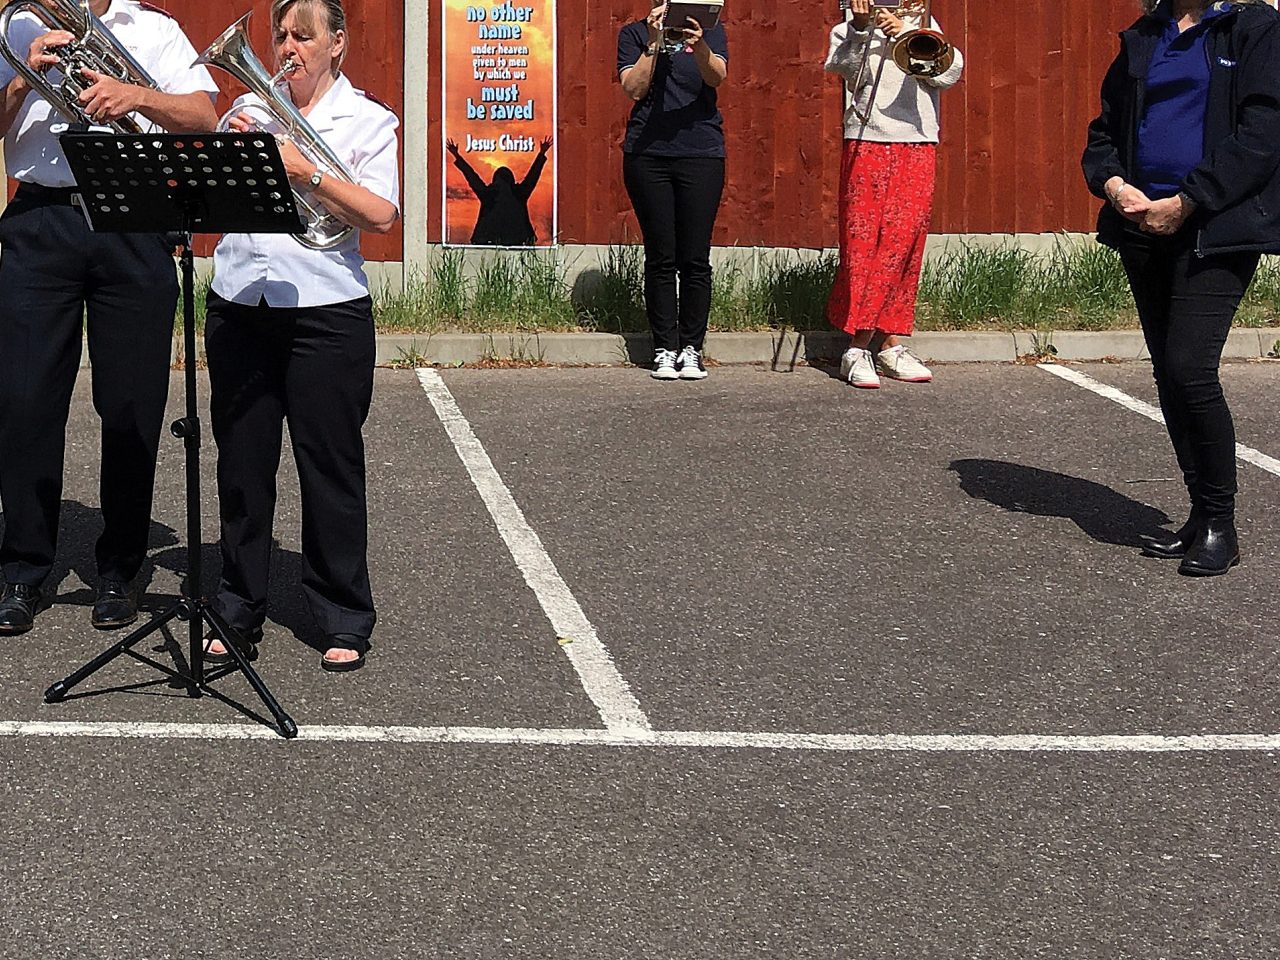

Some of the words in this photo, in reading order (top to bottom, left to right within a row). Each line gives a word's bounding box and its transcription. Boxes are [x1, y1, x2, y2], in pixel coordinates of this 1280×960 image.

[467, 5, 486, 22] no
[491, 0, 533, 22] other
[479, 23, 522, 40] name
[471, 43, 497, 55] under
[498, 43, 529, 55] heaven
[472, 56, 495, 68] given
[497, 56, 507, 68] to
[508, 58, 528, 68] men
[473, 68, 486, 80] by
[487, 67, 512, 80] which
[513, 70, 527, 80] we
[481, 84, 519, 102] must
[466, 98, 487, 120] be
[490, 99, 534, 120] saved
[465, 133, 496, 152] Jesus
[499, 133, 535, 152] Christ
